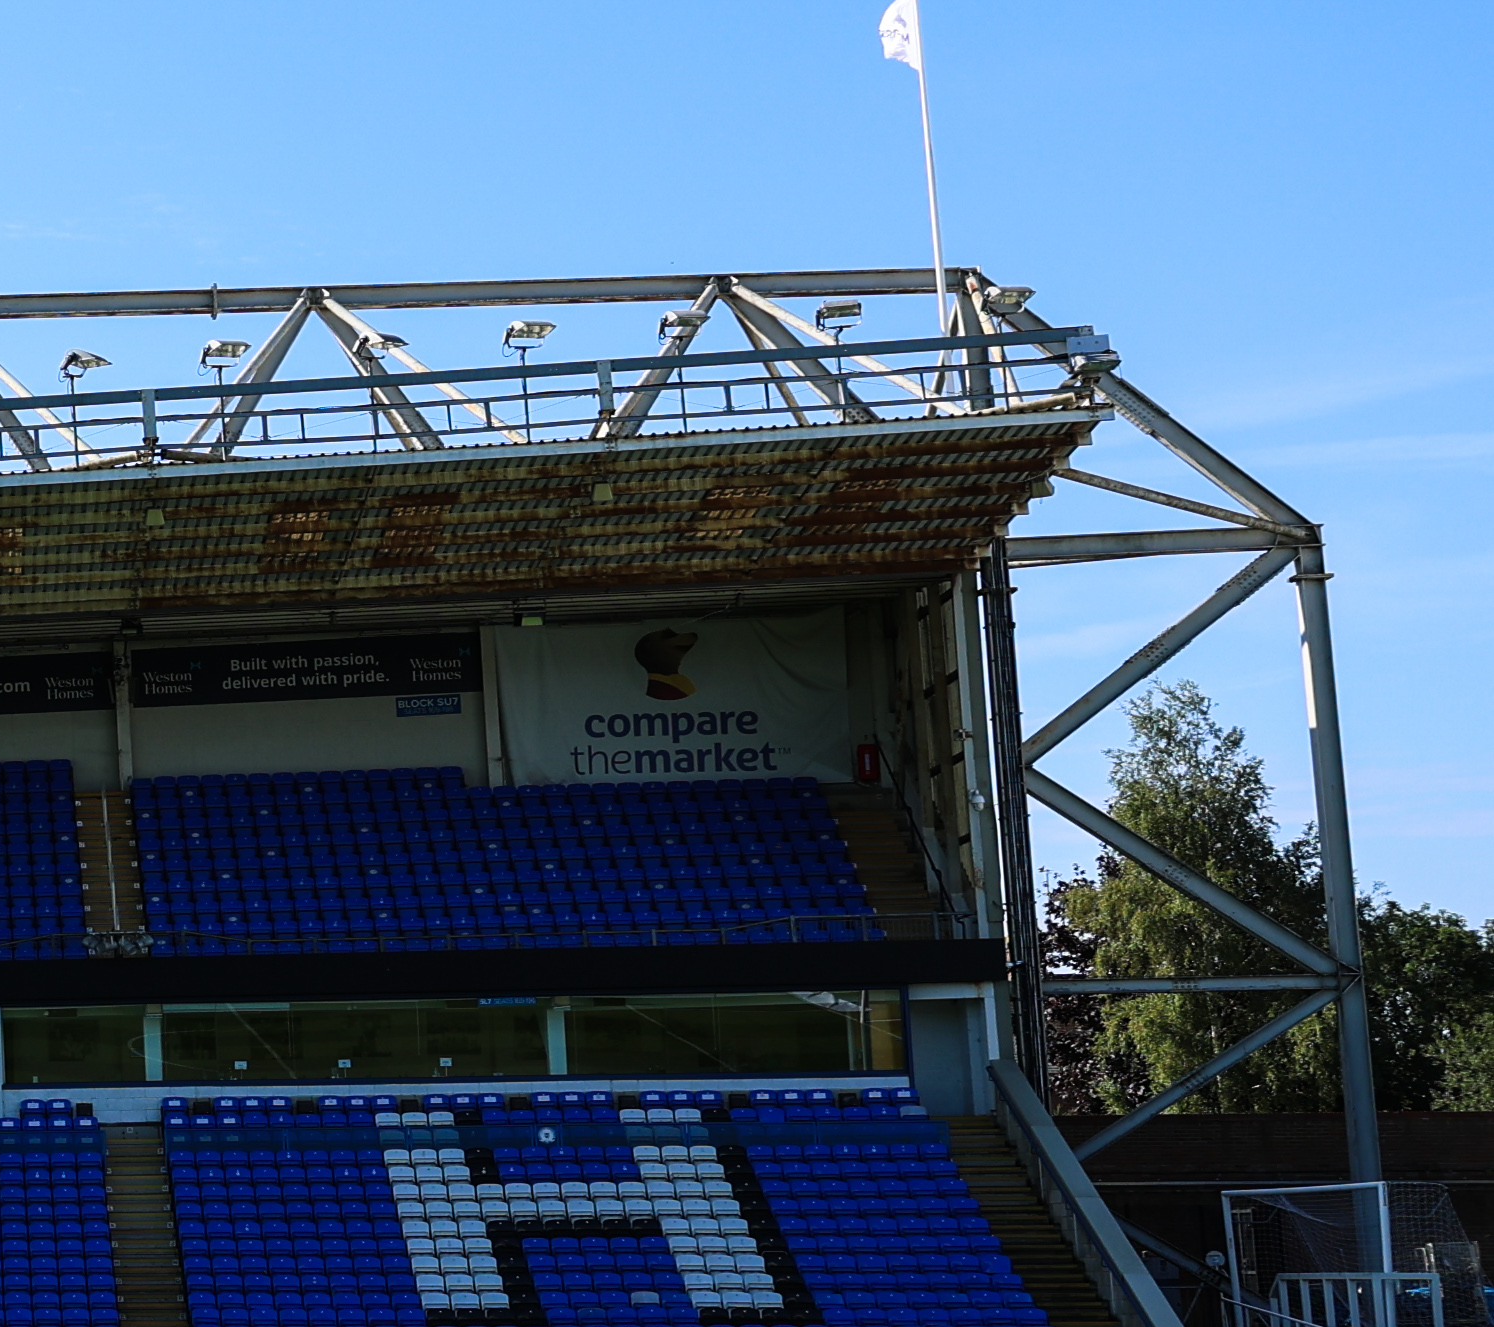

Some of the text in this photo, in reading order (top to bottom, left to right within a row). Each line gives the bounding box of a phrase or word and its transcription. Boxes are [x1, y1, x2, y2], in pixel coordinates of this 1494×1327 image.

[231, 653, 380, 672] Built with passion,
[409, 658, 462, 670] Weston
[45, 676, 95, 688] Weston
[142, 671, 193, 683] Weston
[222, 669, 390, 690] delivered with pride.
[411, 670, 462, 683] Homes
[47, 688, 95, 700] Homes
[144, 682, 193, 695] Homes
[398, 697, 459, 709] BLOCK SU7
[584, 710, 759, 743] compare
[570, 741, 778, 776] themarket
